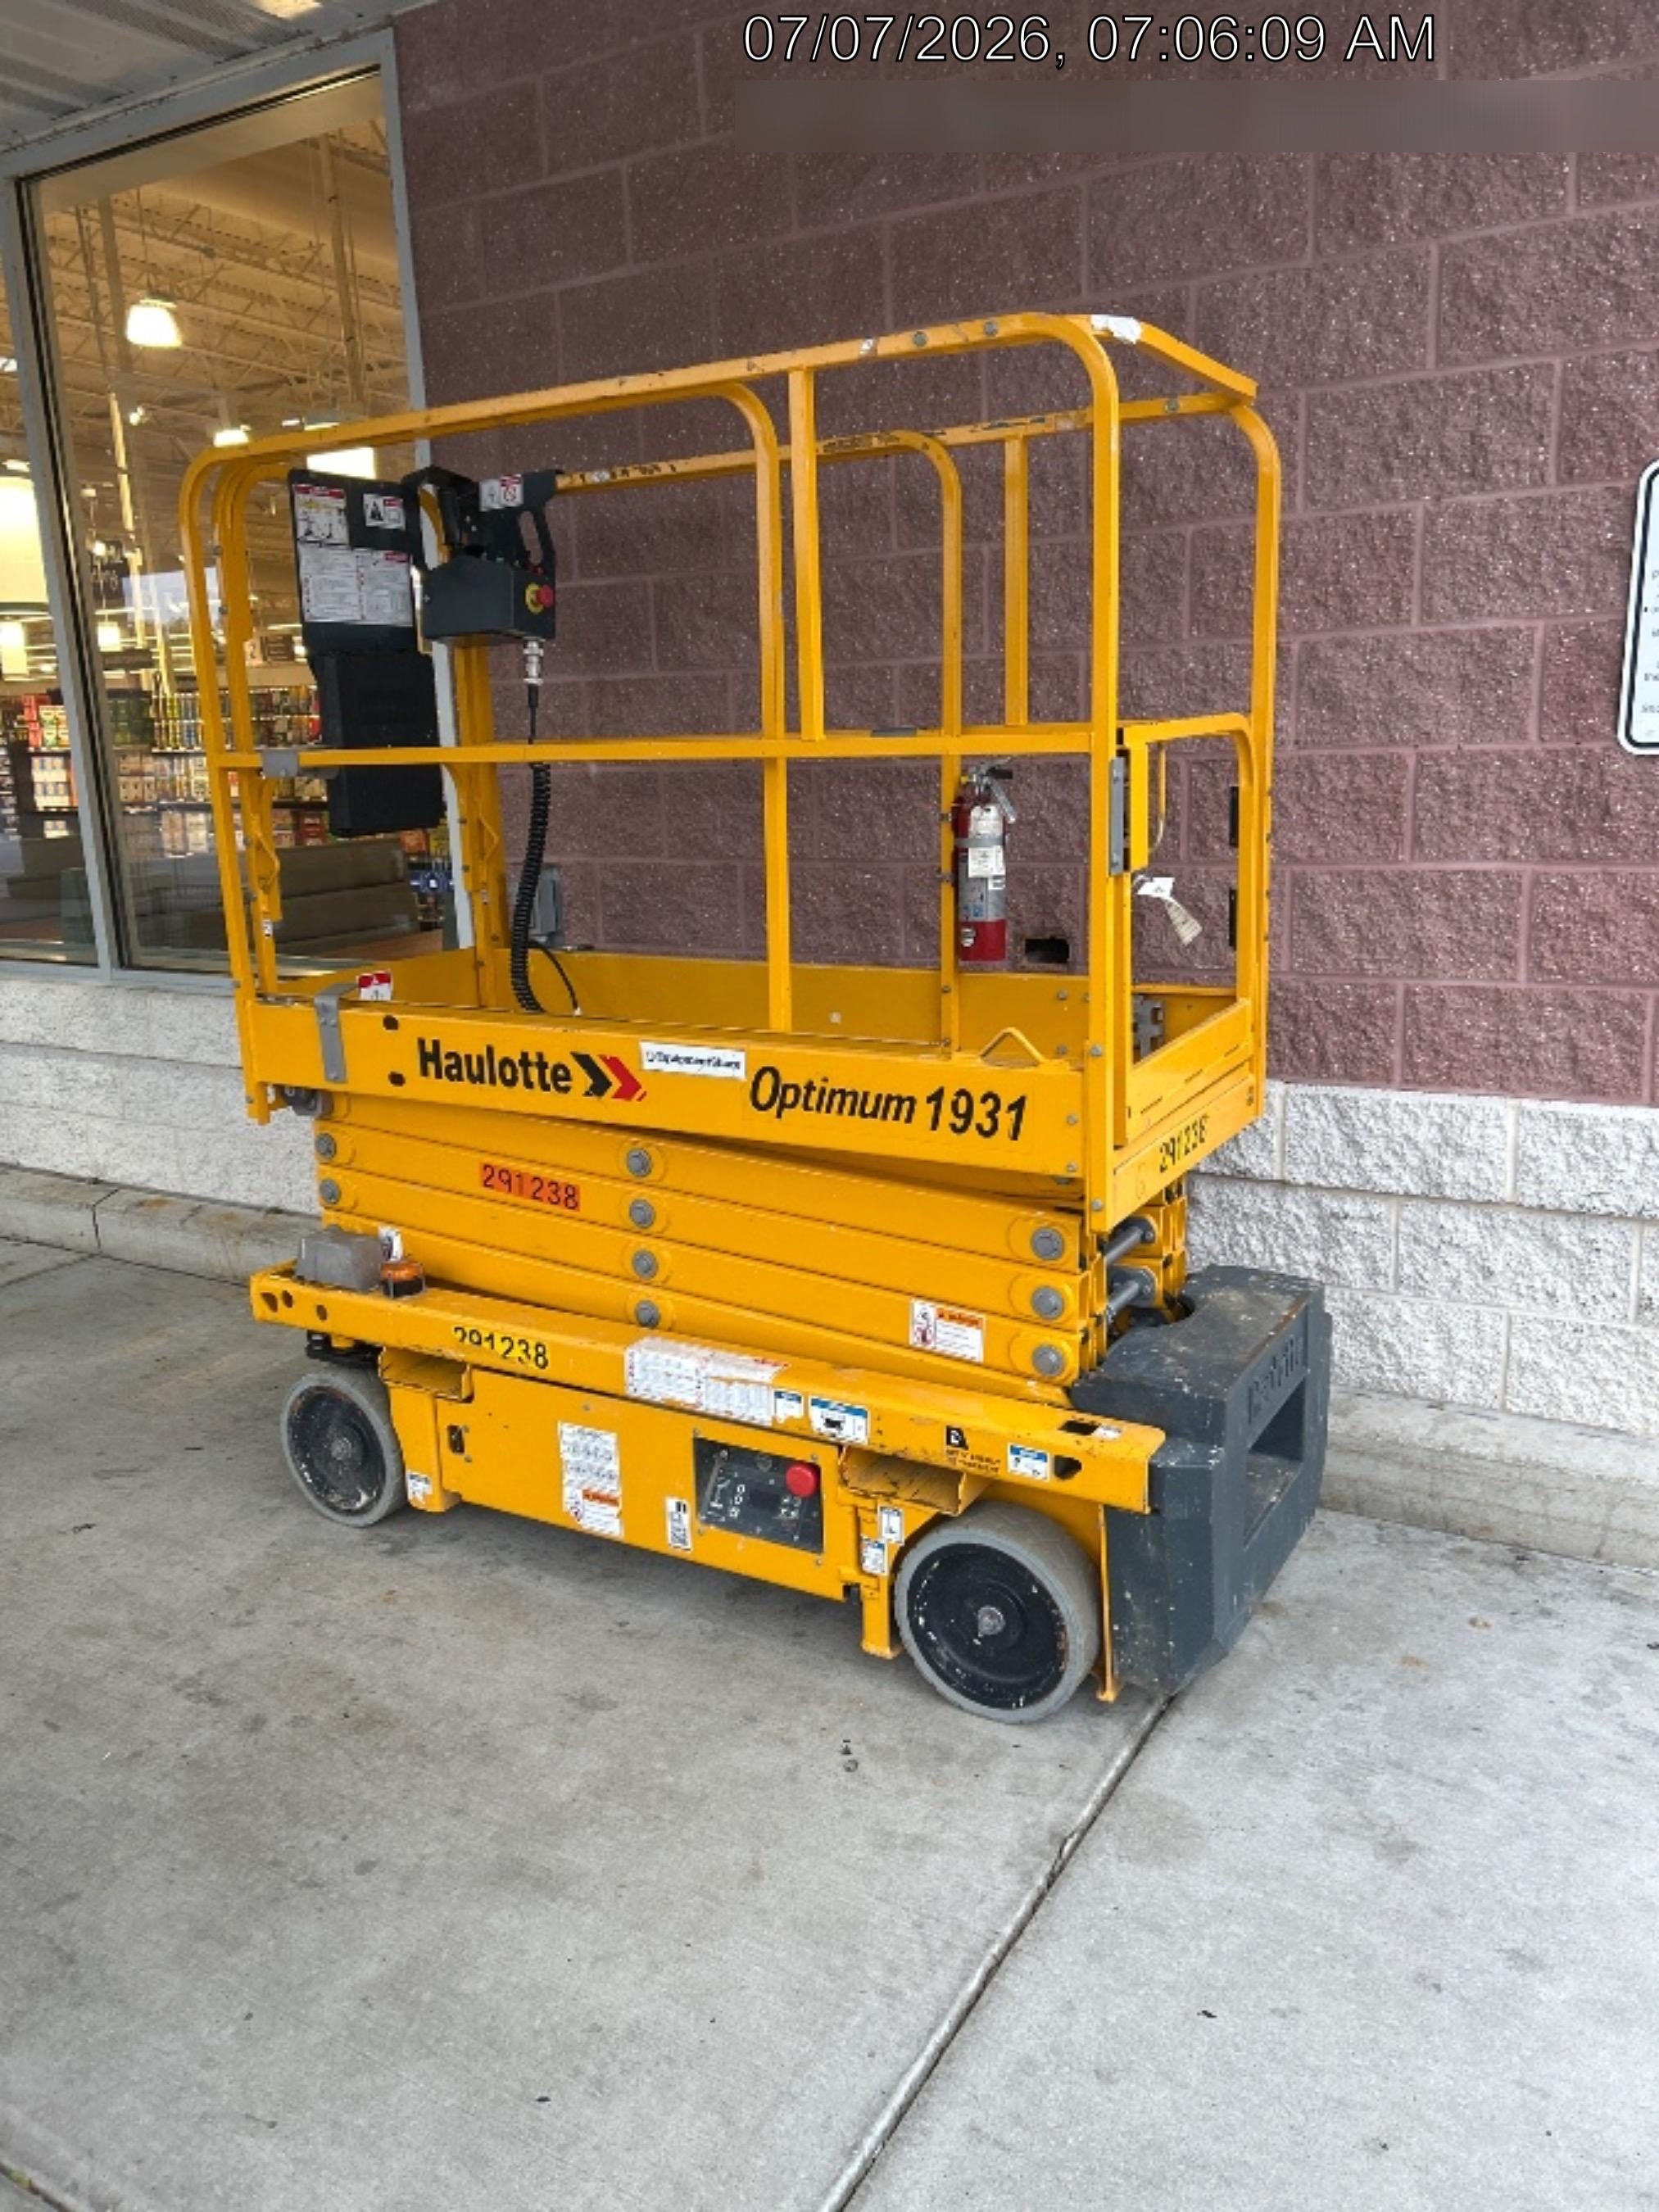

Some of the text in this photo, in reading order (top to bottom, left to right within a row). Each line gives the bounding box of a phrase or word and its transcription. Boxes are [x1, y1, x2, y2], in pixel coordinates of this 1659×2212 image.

[418, 1037, 573, 1095] Haulotte
[749, 1065, 1027, 1141] Optimum 1931
[482, 1163, 580, 1211] 291238
